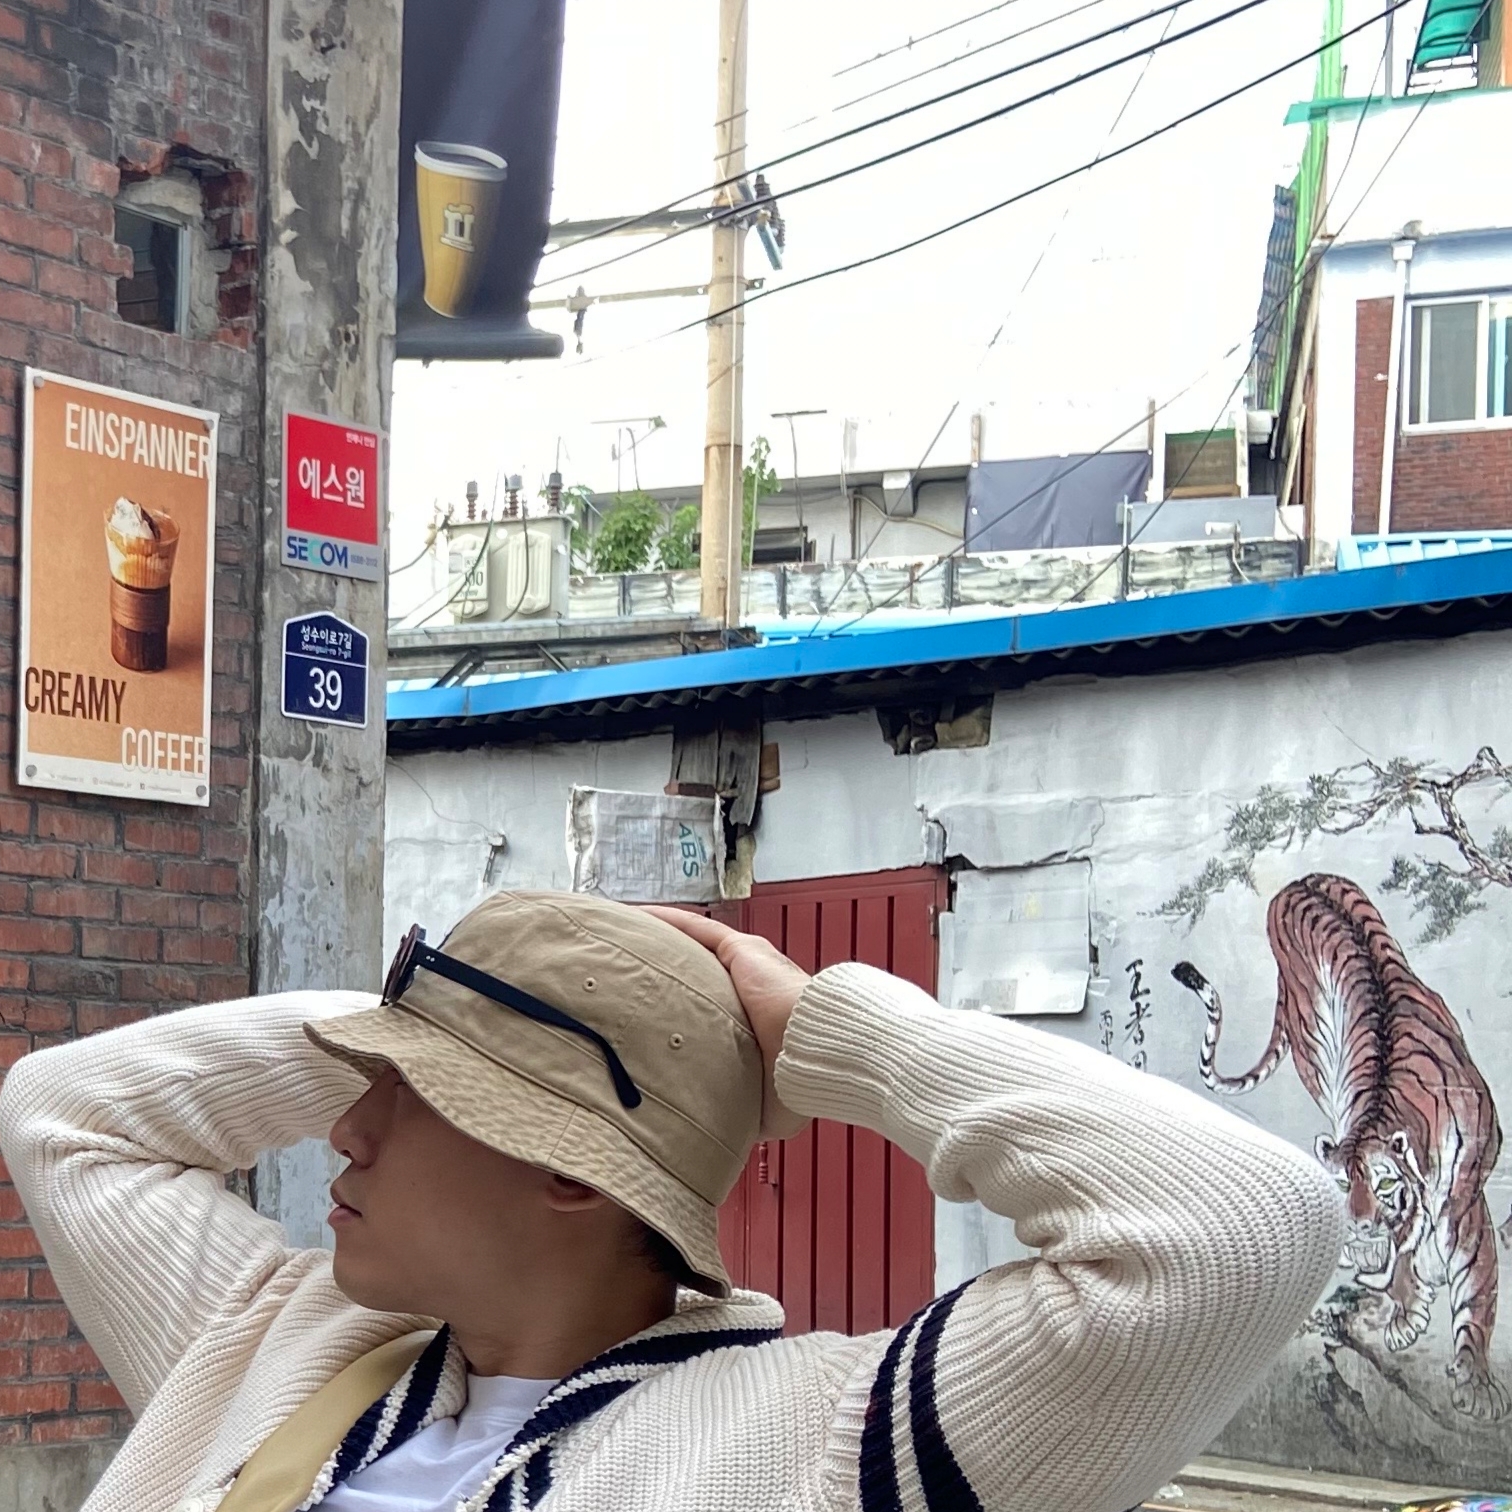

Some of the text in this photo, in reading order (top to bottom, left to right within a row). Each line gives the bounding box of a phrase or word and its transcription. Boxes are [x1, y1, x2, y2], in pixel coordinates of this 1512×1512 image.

[65, 402, 213, 480] EINSPANNER
[298, 456, 365, 509] 에스원
[286, 536, 348, 569] SECOM
[300, 624, 353, 650] 성수이로7길
[24, 666, 127, 724] CREAMY
[308, 667, 342, 711] 39
[121, 726, 207, 780] COFFEE
[678, 822, 699, 878] ABS
